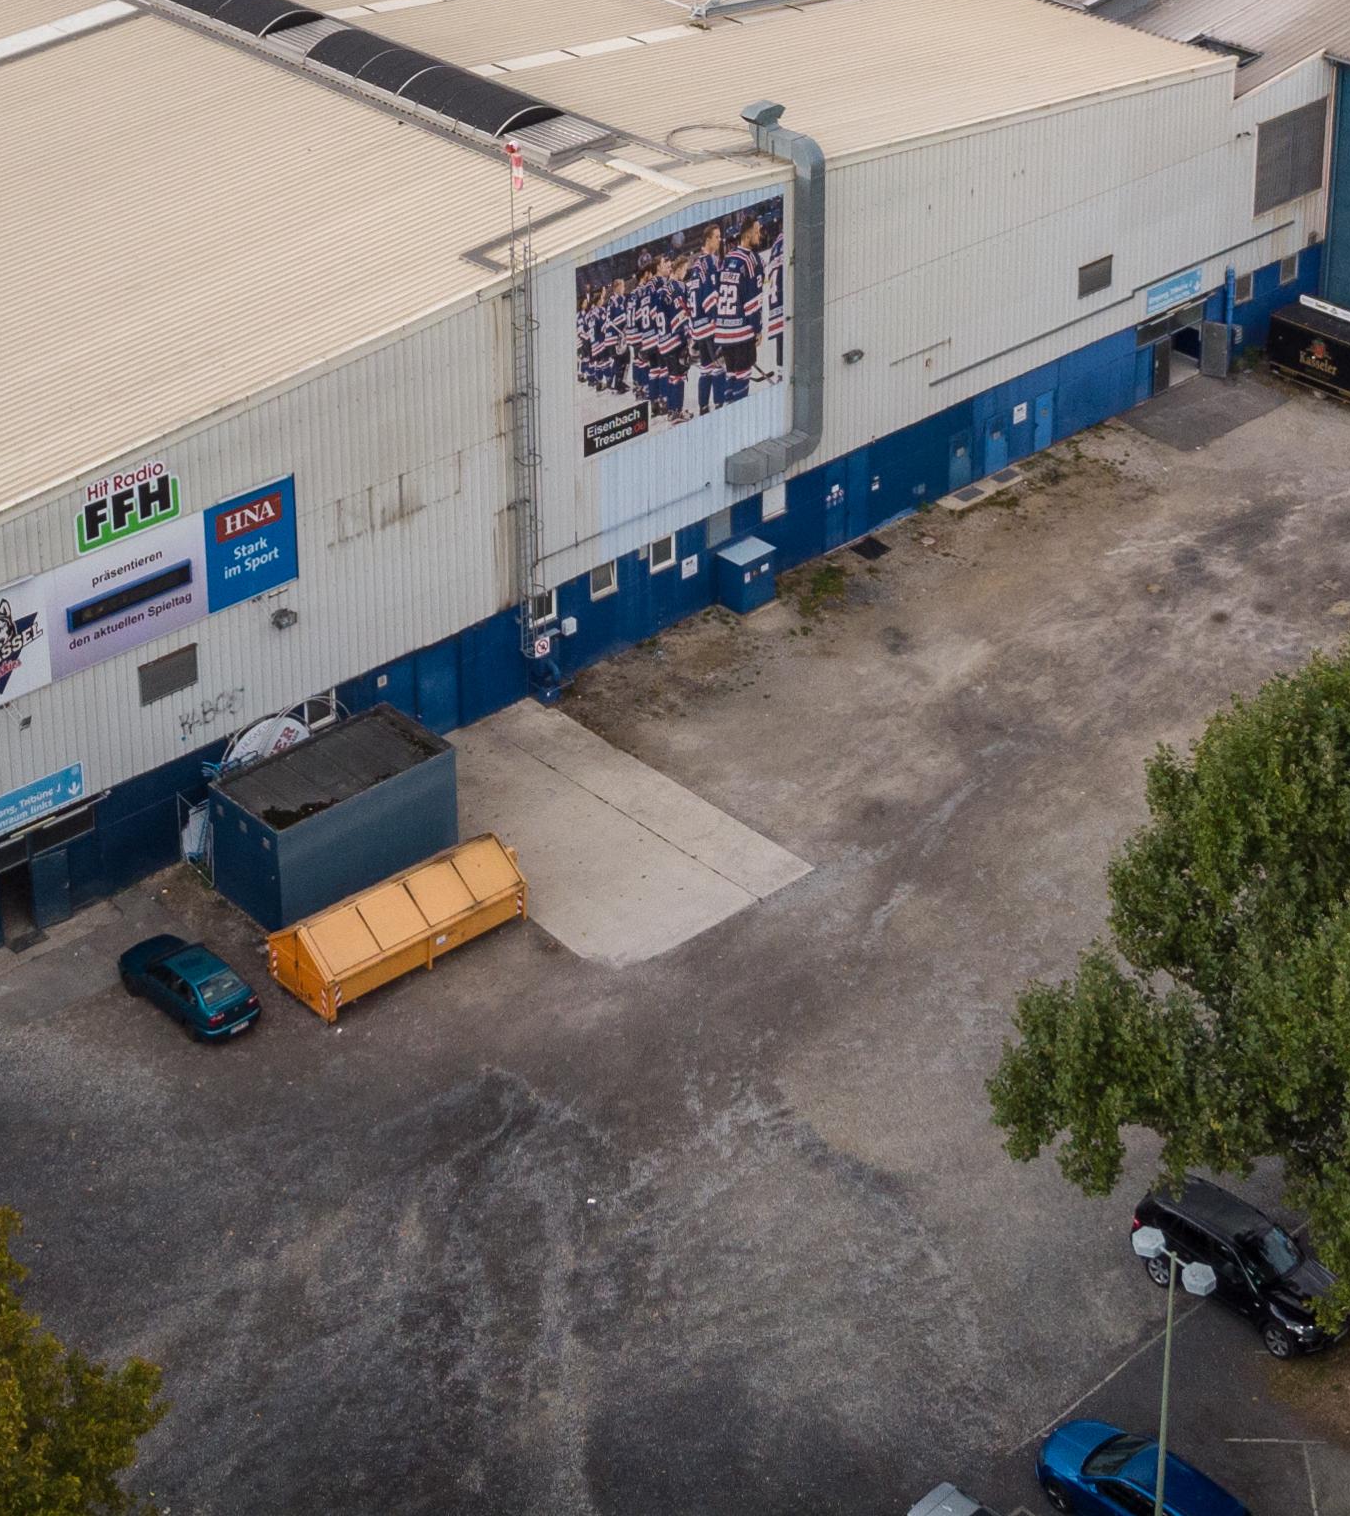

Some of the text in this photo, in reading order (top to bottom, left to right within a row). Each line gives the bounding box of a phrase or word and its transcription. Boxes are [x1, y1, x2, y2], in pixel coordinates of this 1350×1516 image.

[717, 284, 738, 315] 22
[587, 409, 641, 439] Eisenbach
[87, 460, 164, 503] Hit Radio
[83, 474, 172, 542] FFH
[224, 500, 276, 537] HNA
[224, 547, 280, 579] im Sport
[233, 537, 268, 561] Stark
[91, 550, 163, 588] präsentieren
[69, 592, 193, 650] den aktuellen Spieltag
[19, 788, 54, 808] Tribüne
[31, 799, 54, 814] links
